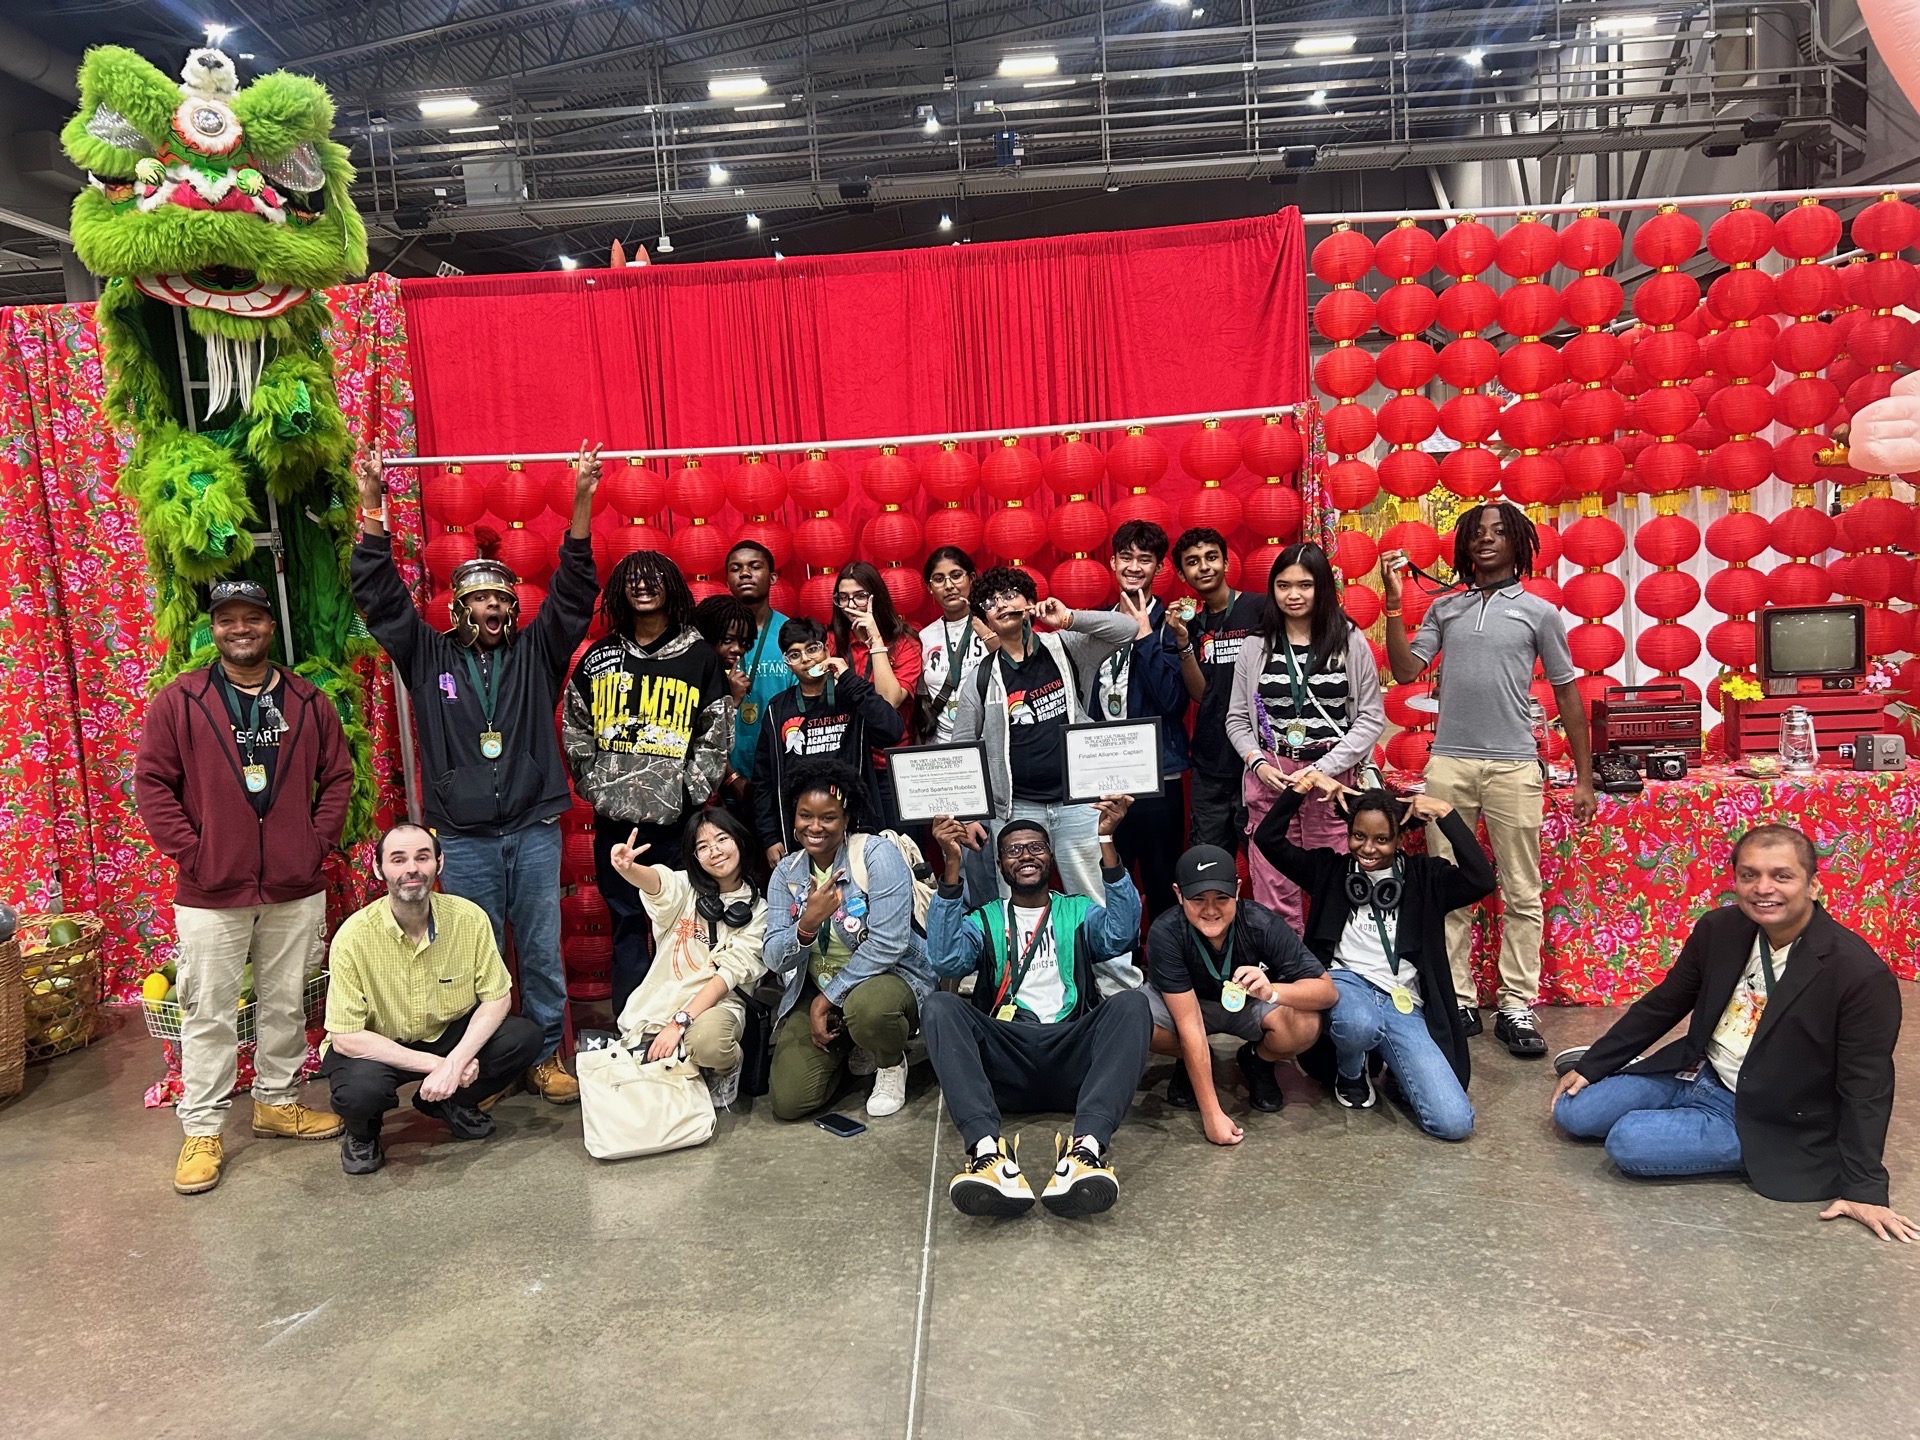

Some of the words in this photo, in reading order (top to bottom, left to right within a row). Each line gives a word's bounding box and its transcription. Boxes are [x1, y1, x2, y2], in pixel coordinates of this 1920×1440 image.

[1214, 629, 1249, 639] STAFFOR
[1215, 640, 1229, 649] STEM
[1216, 646, 1241, 656] ACADEM
[585, 653, 602, 671] STREET
[1216, 655, 1237, 664] ROBOTI
[1029, 679, 1064, 700] STAFFOR
[1032, 695, 1049, 709] STEM
[1048, 687, 1065, 701] MAG
[1037, 703, 1067, 722] ROBOTICS
[807, 714, 850, 728] STAFFORD
[807, 727, 824, 737] STEM
[806, 733, 842, 746] ACADEMY
[613, 741, 633, 753] OUR
[806, 742, 841, 755] ROBOTICS
[243, 766, 265, 775] 2026
[1353, 883, 1364, 896] R
[1382, 887, 1391, 901] L
[1358, 922, 1393, 933] ROBOS
